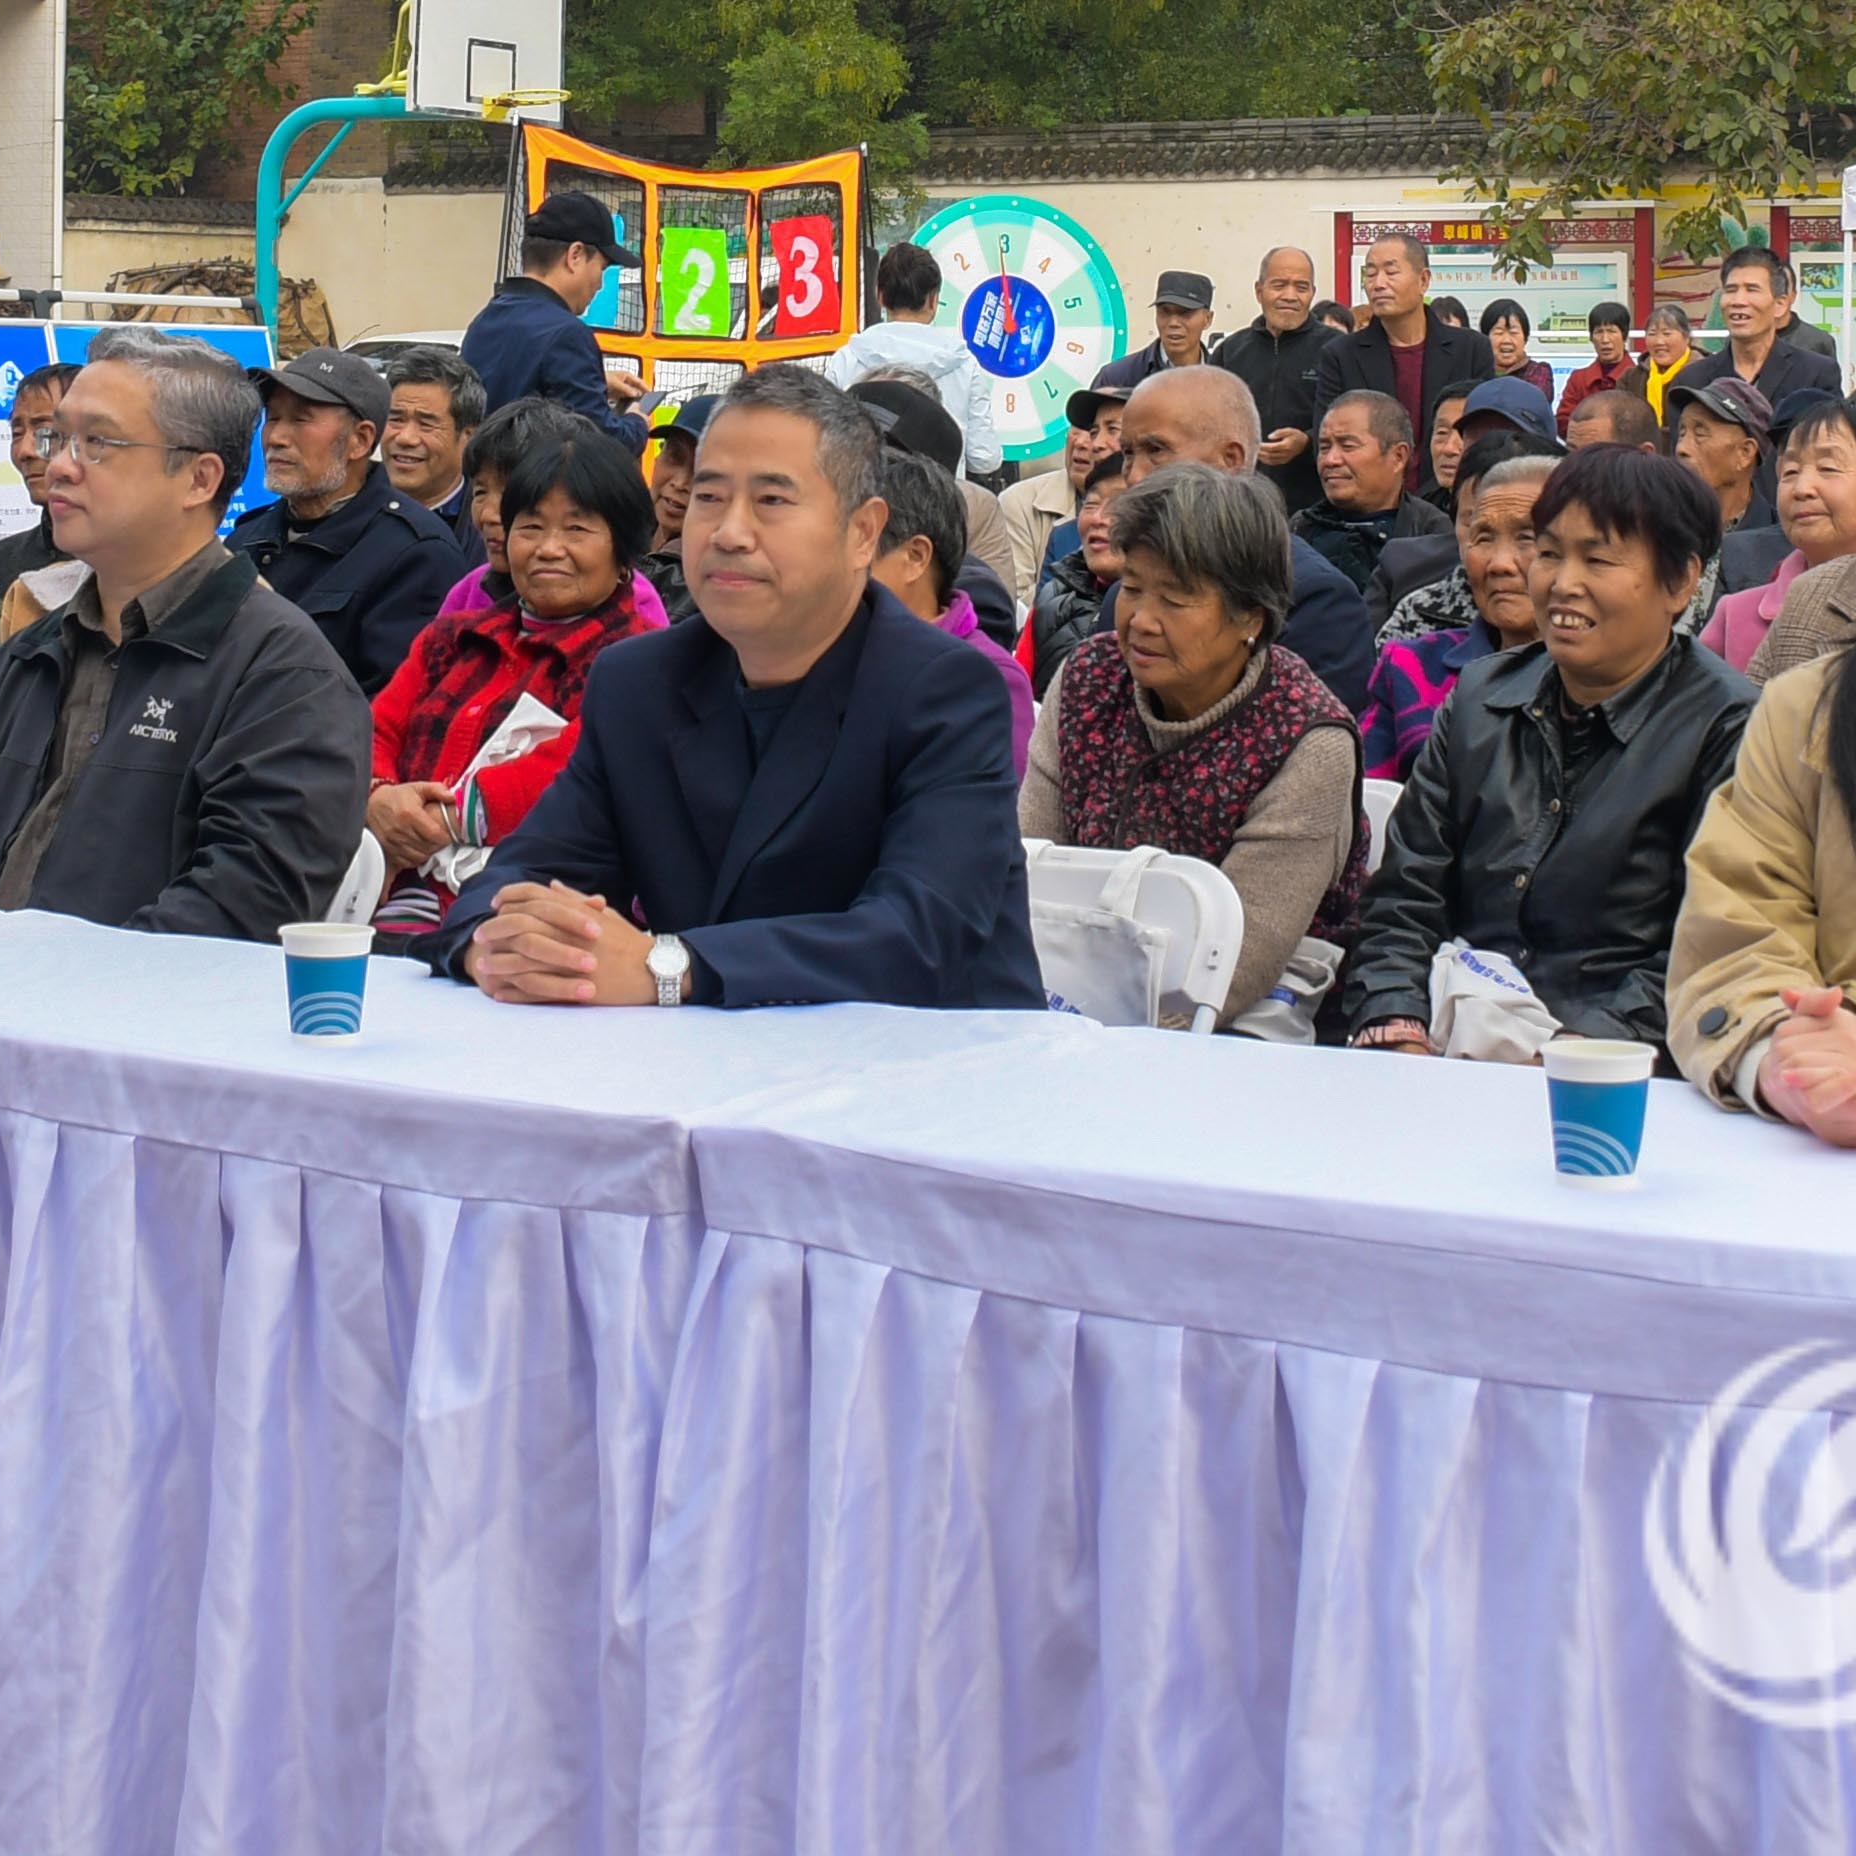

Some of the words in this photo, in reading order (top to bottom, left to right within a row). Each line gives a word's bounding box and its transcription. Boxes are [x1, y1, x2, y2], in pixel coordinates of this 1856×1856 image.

[953, 251, 971, 272] 2
[1038, 256, 1053, 275] 4
[785, 235, 823, 318] 3
[673, 247, 716, 332] 2
[1063, 296, 1084, 311] 5
[1043, 379, 1060, 400] 7
[1005, 393, 1016, 413] 8
